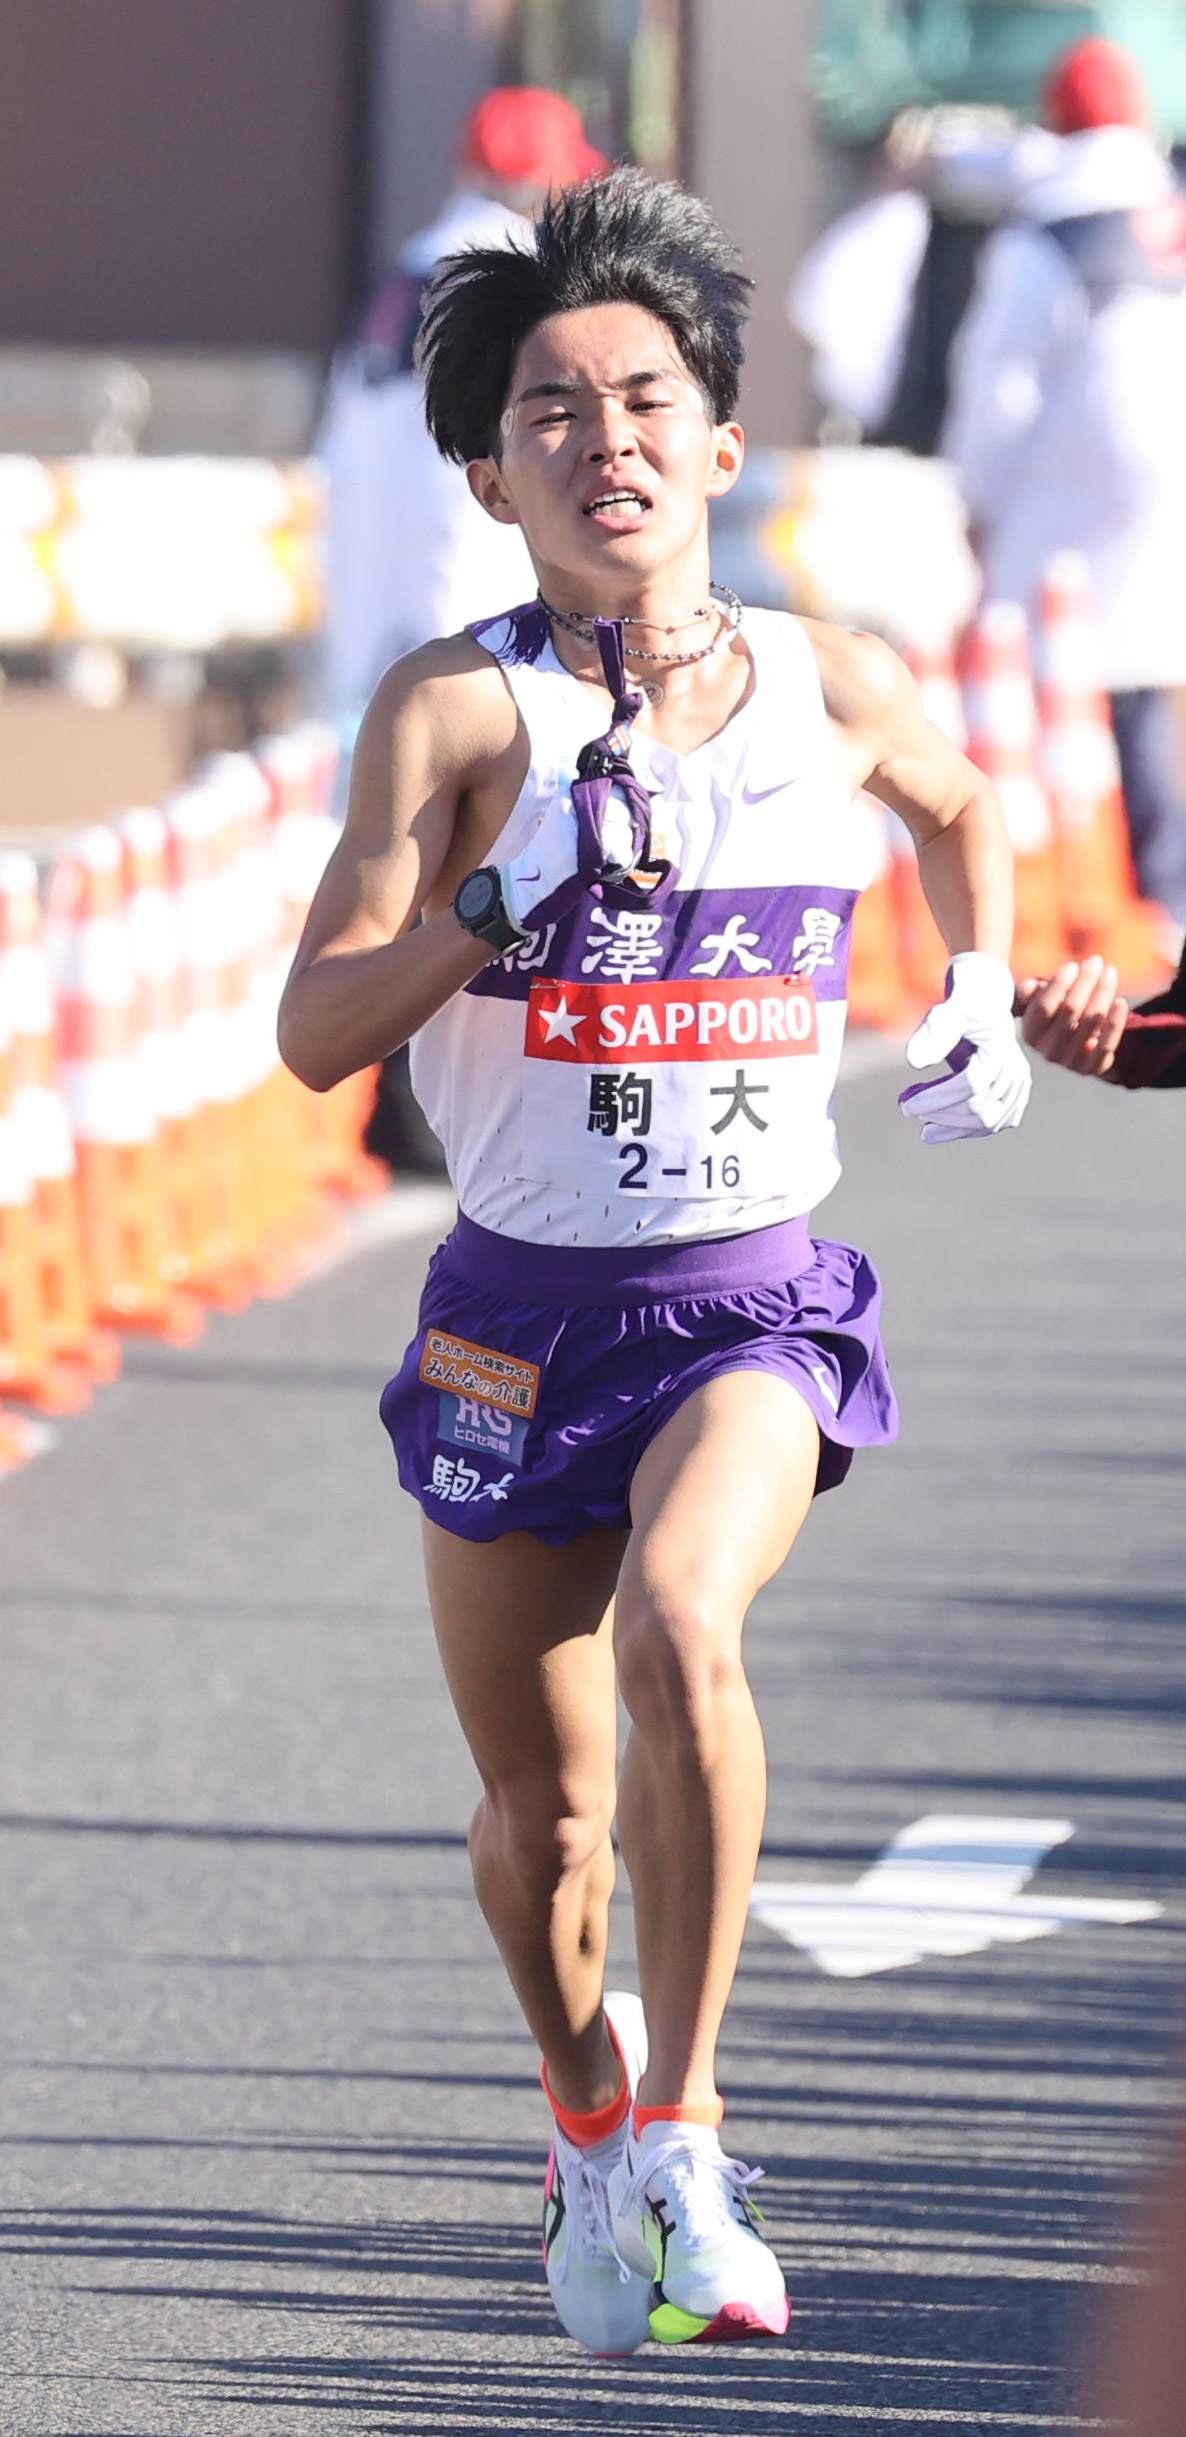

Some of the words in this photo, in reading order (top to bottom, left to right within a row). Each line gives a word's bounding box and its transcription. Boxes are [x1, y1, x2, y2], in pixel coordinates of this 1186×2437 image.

[598, 995, 812, 1048] SAPPORO
[586, 1068, 770, 1137] 駒大
[618, 1142, 741, 1190] 2-16
[424, 1358, 532, 1411] みんなの介護
[430, 1336, 534, 1384] 老人ホーム検索サイト
